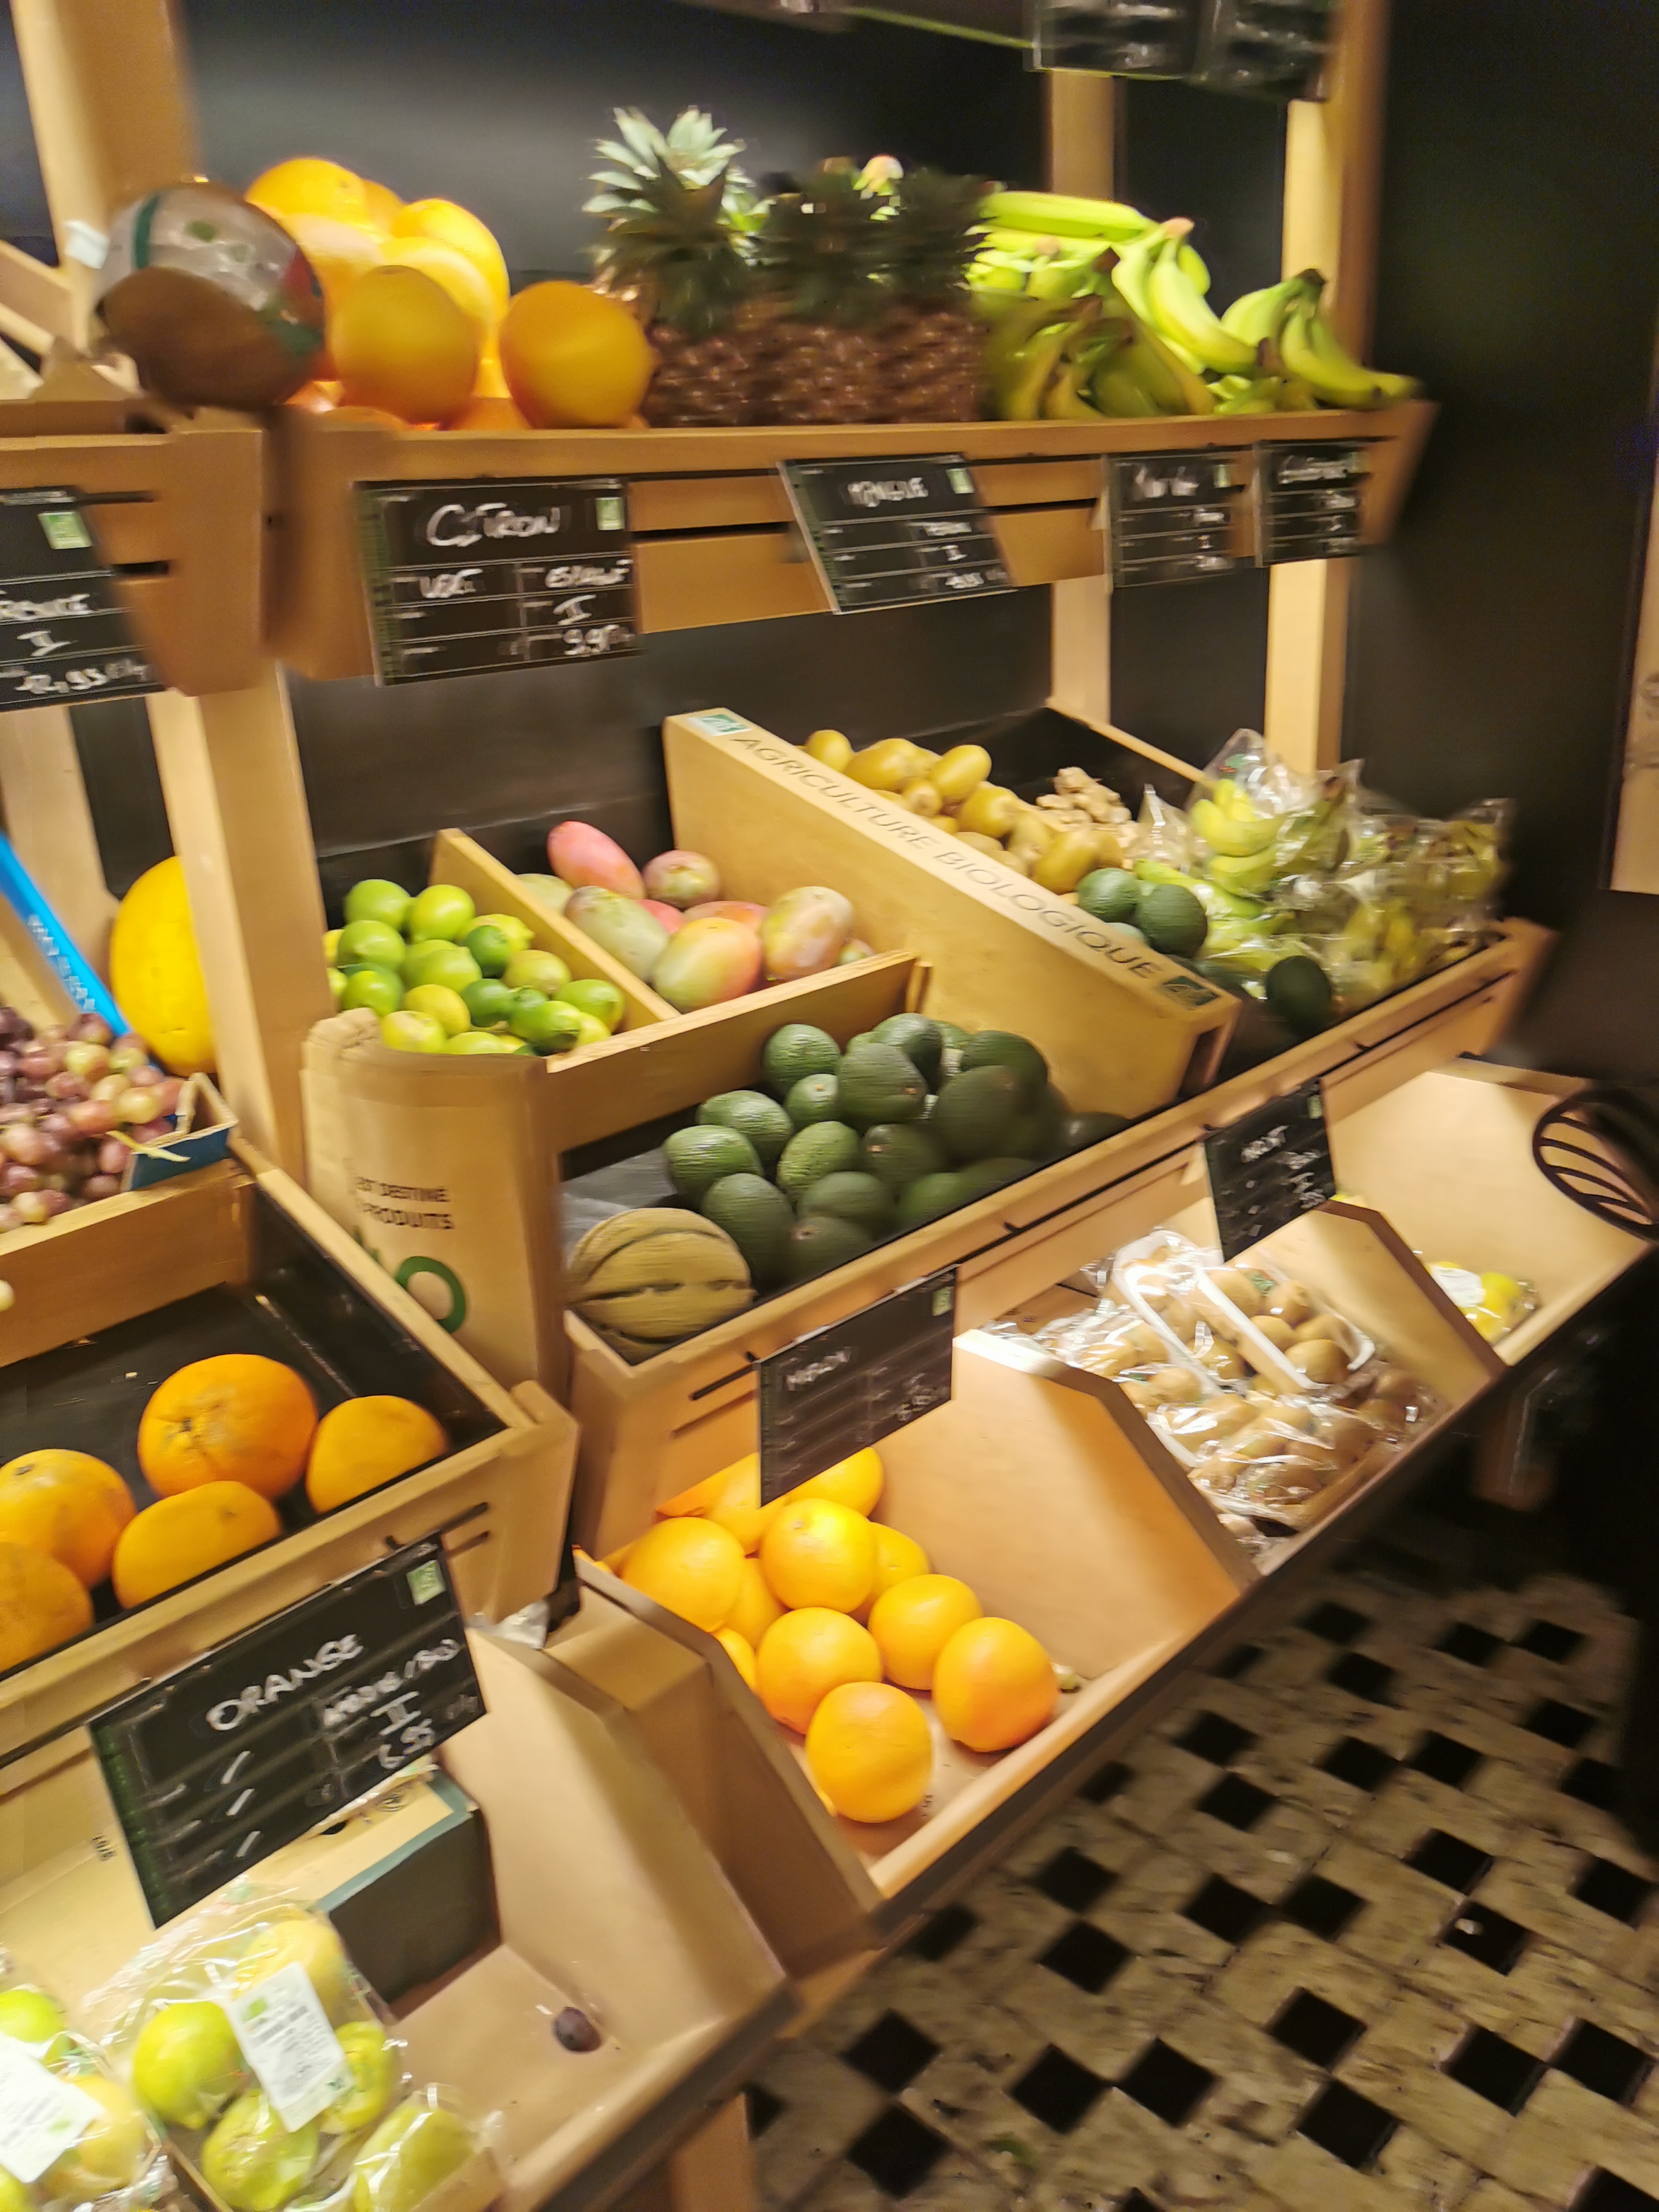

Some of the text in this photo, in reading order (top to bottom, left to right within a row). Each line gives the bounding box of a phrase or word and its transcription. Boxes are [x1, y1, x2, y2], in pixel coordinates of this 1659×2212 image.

[730, 737, 1163, 980] AGRICULTURE BIOLOGIQUE
[206, 1634, 363, 1731] ORANGE
